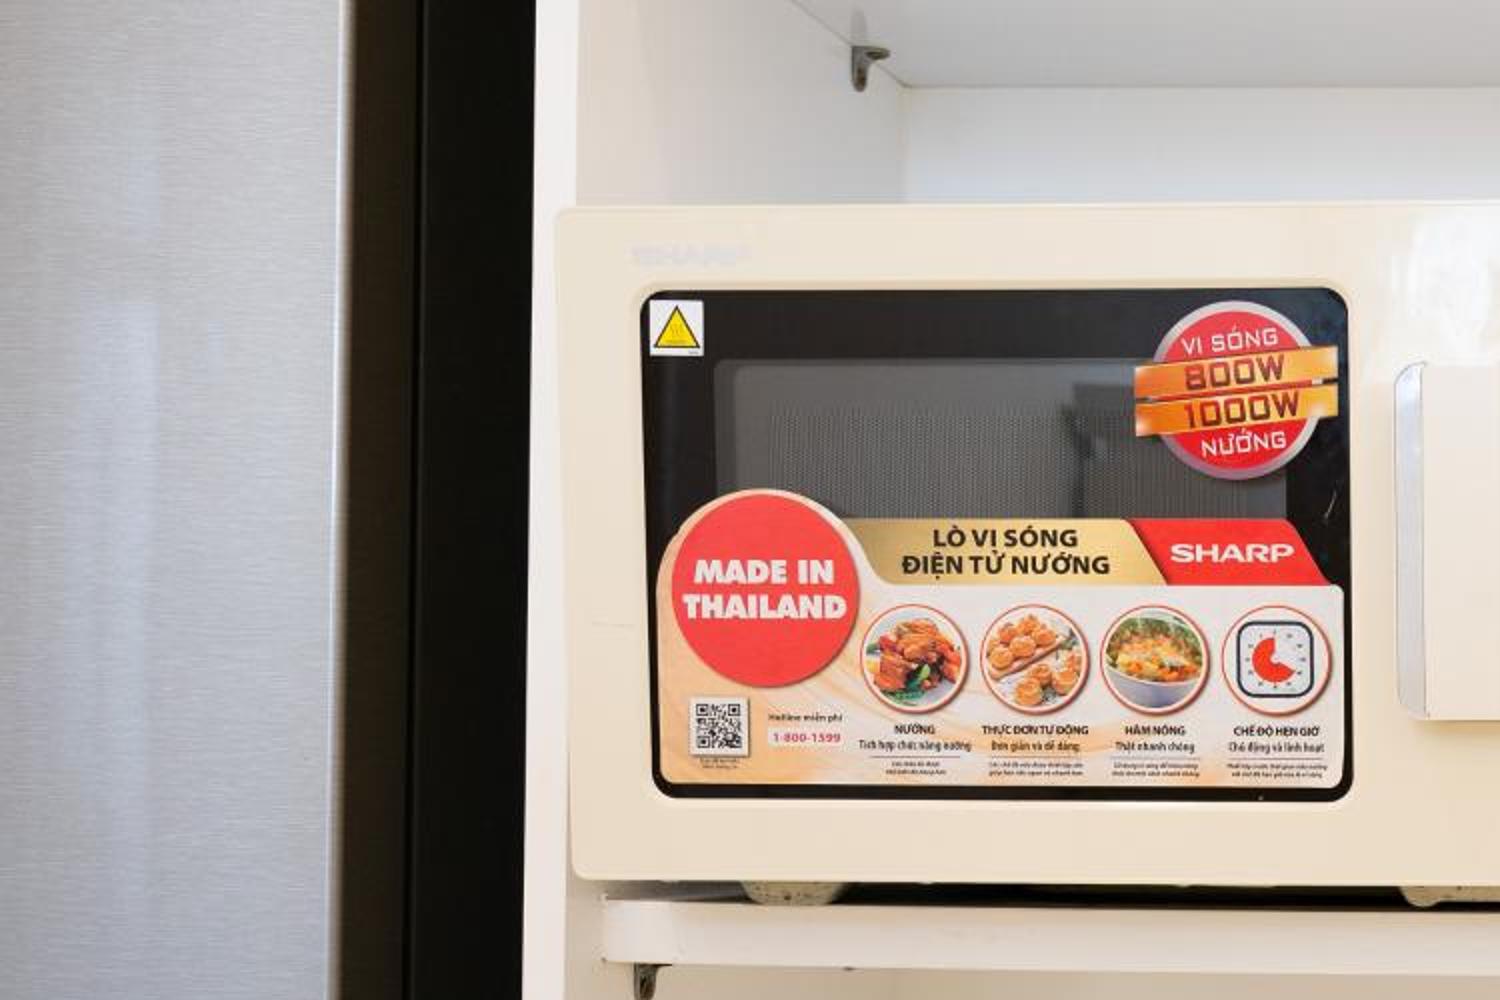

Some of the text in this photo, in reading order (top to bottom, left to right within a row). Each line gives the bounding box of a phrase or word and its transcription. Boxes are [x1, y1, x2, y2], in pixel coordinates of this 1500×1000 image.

[1182, 323, 1279, 355] VI SÓNG
[1184, 354, 1285, 391] 800W
[1184, 391, 1299, 428] 1000W
[1201, 428, 1286, 458] NƯỚNG
[933, 524, 1078, 547] LÒ VI SÓNG
[902, 551, 963, 580] ĐIỆN
[1011, 551, 1110, 574] NƯỚNG
[1170, 543, 1295, 563] SHARP
[694, 559, 834, 585] MADE IN
[682, 595, 847, 619] THAILAND
[773, 732, 841, 743] 1-800-1599
